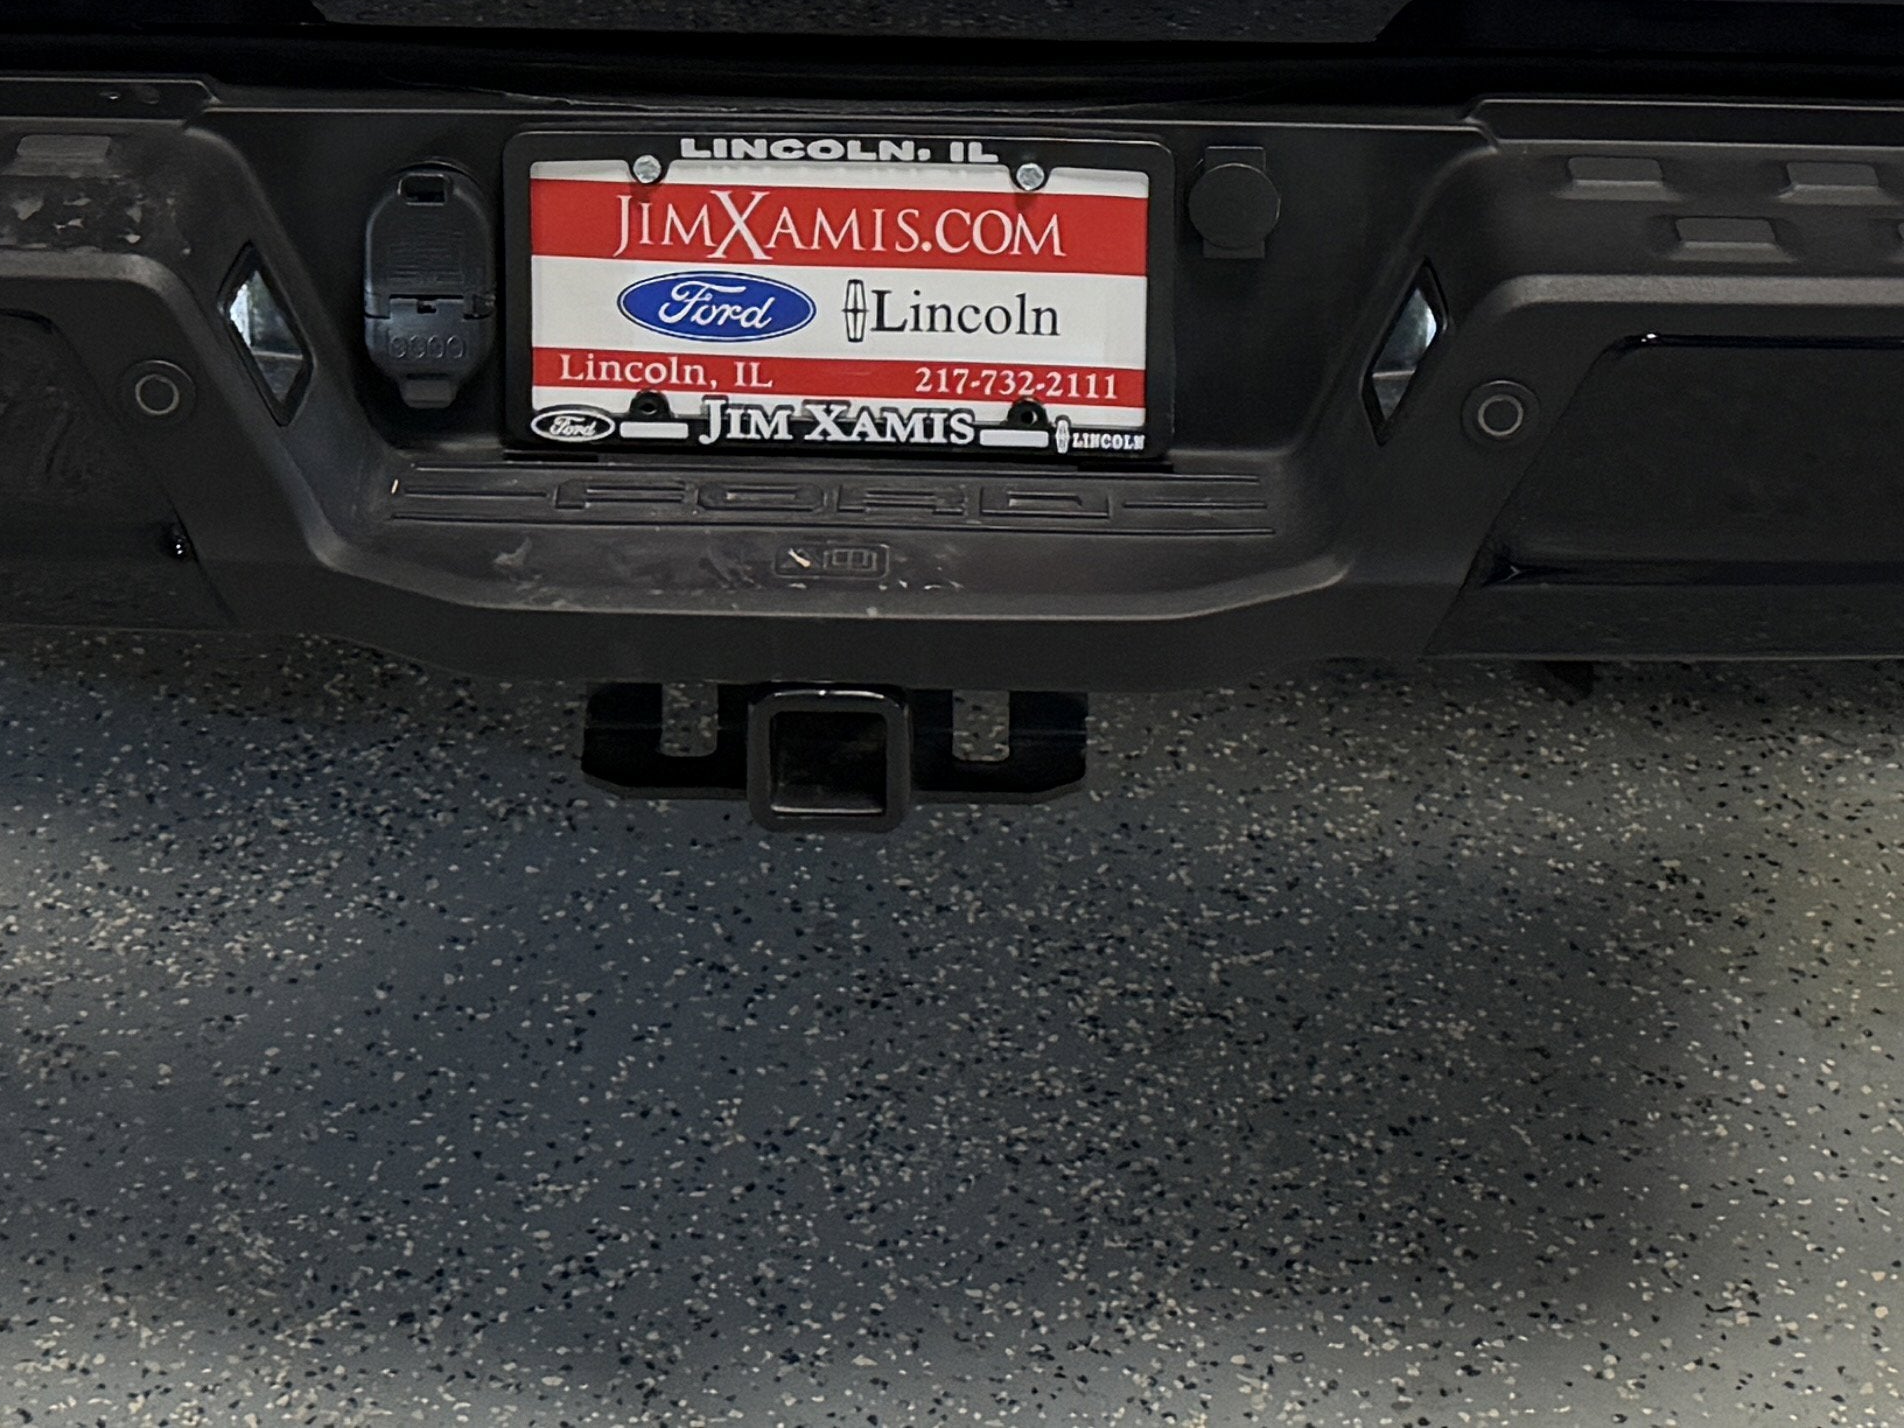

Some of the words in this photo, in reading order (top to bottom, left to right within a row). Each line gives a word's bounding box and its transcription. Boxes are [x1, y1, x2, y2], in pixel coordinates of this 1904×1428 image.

[949, 140, 1000, 163] IL
[613, 189, 1067, 261] JIMXAMIS.COM
[658, 279, 774, 330] Ford
[870, 289, 1061, 337] Lincoln
[560, 353, 718, 390] Lincoln,
[733, 361, 773, 389] IL
[914, 366, 1119, 400] 217-732-2111
[549, 414, 597, 438] Ford
[698, 398, 795, 445] JIM
[802, 403, 976, 445] XAMIS
[1071, 431, 1146, 451] LINCOLN
